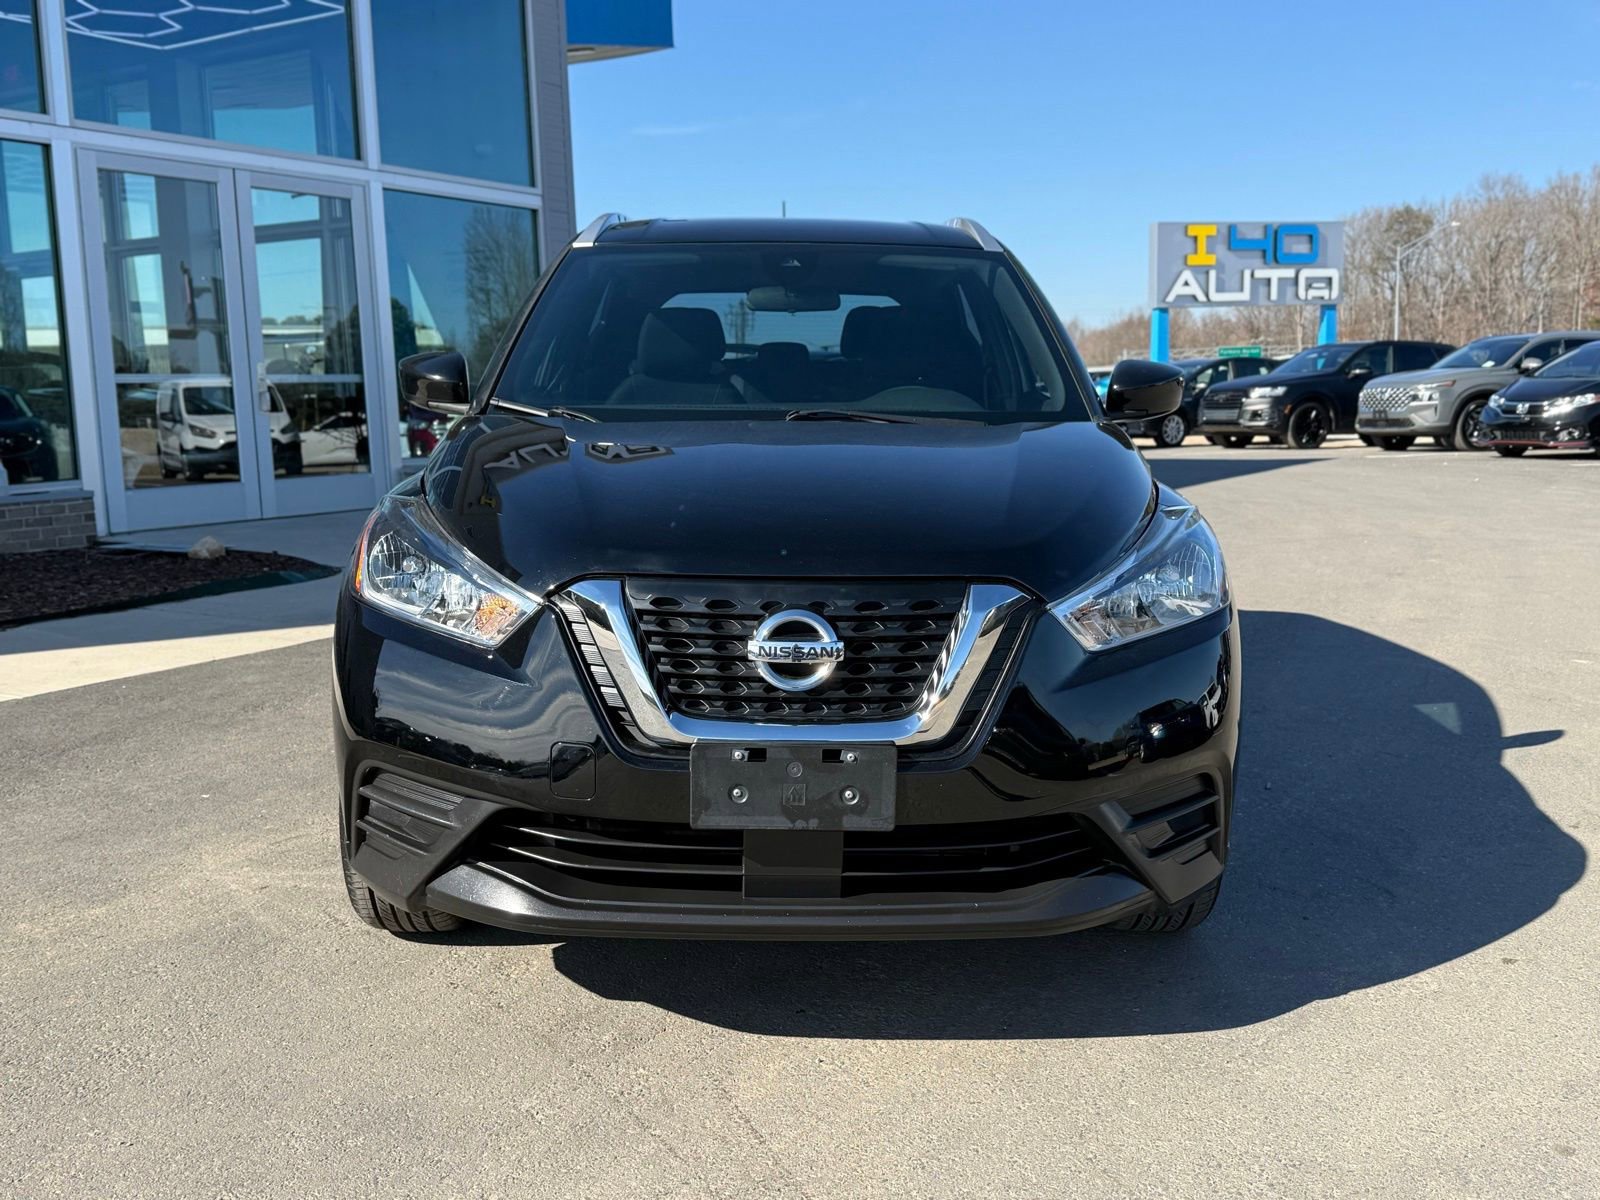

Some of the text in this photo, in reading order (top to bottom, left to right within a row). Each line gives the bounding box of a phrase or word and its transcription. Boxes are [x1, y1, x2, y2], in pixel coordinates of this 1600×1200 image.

[1186, 224, 1319, 266] I 40
[758, 645, 834, 658] NISSAN
